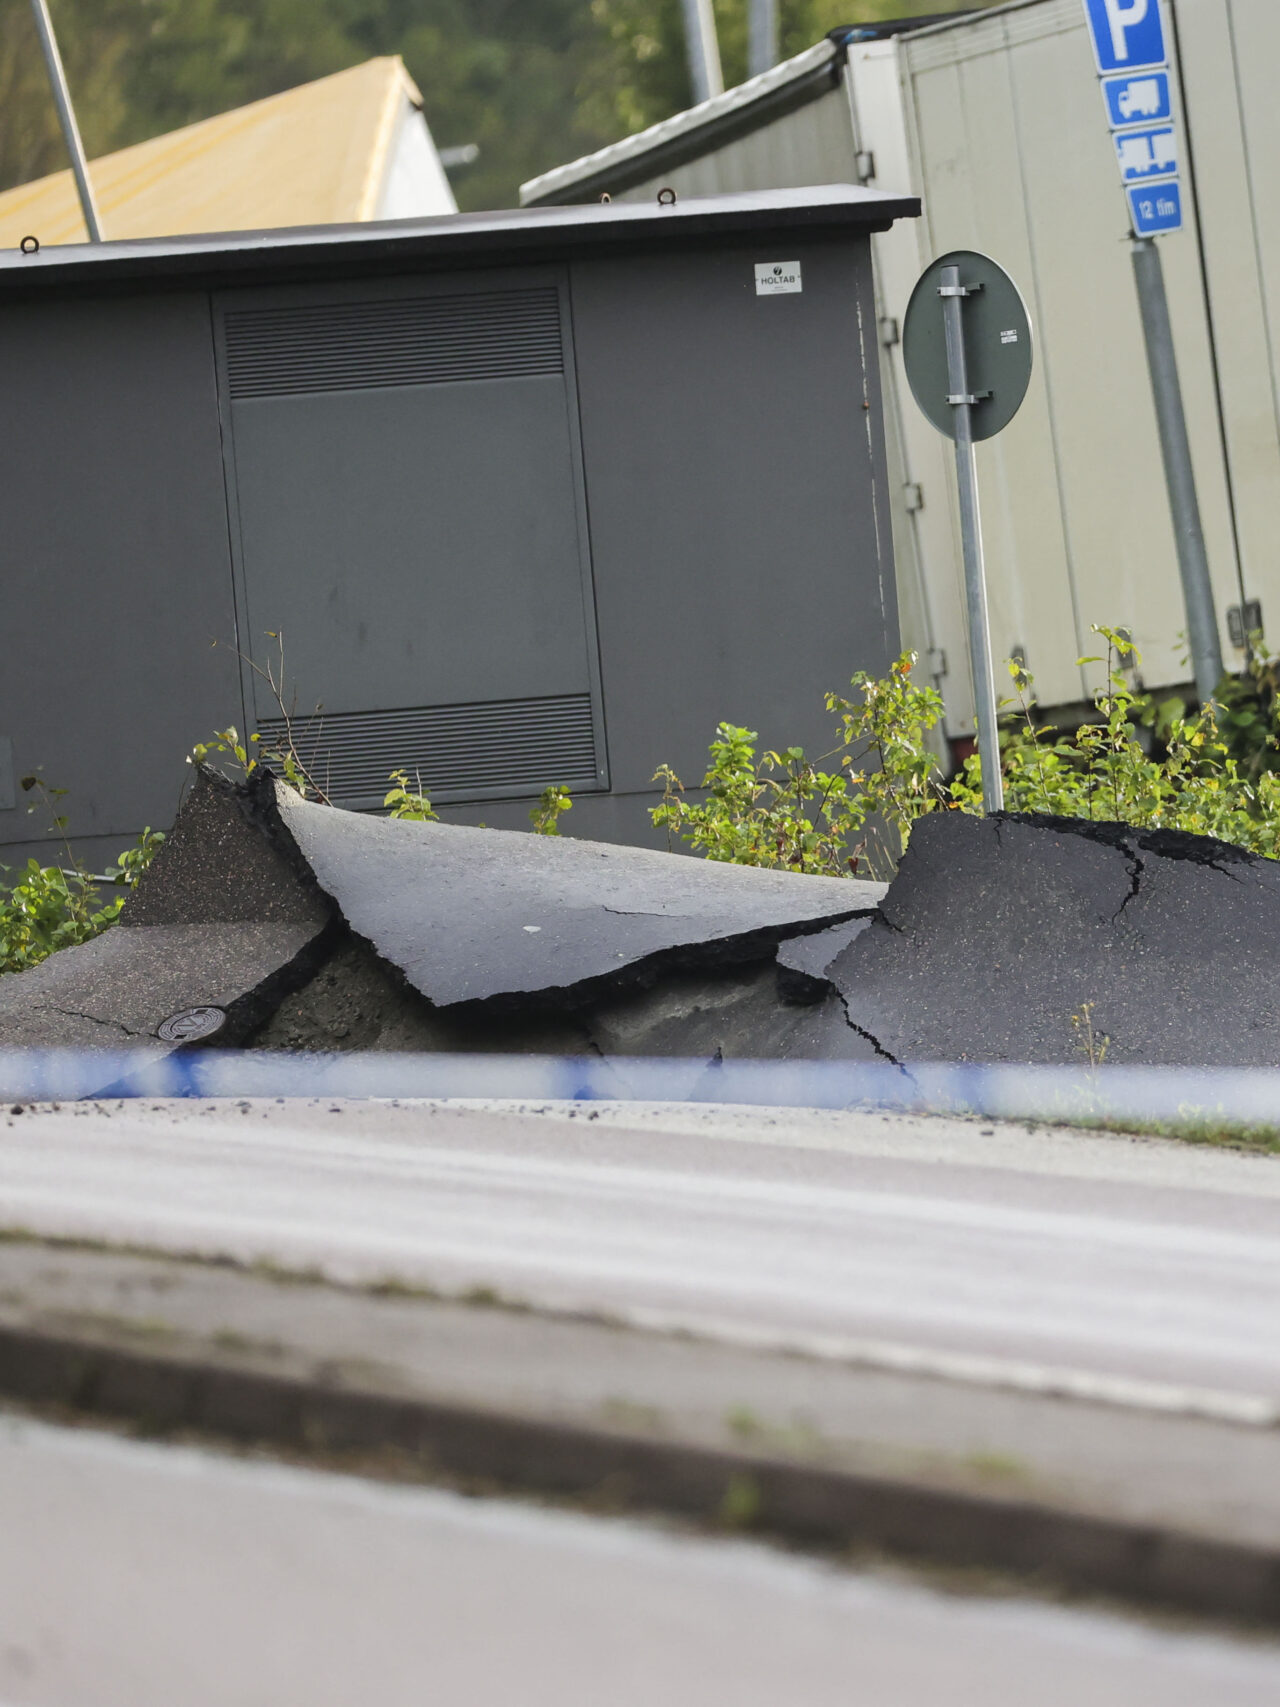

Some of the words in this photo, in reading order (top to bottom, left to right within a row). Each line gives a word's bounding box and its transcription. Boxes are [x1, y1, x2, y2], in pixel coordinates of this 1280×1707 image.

[1105, 0, 1149, 60] P
[1139, 199, 1155, 220] 12
[1156, 197, 1177, 217] tim
[761, 274, 796, 286] HOLTAB
